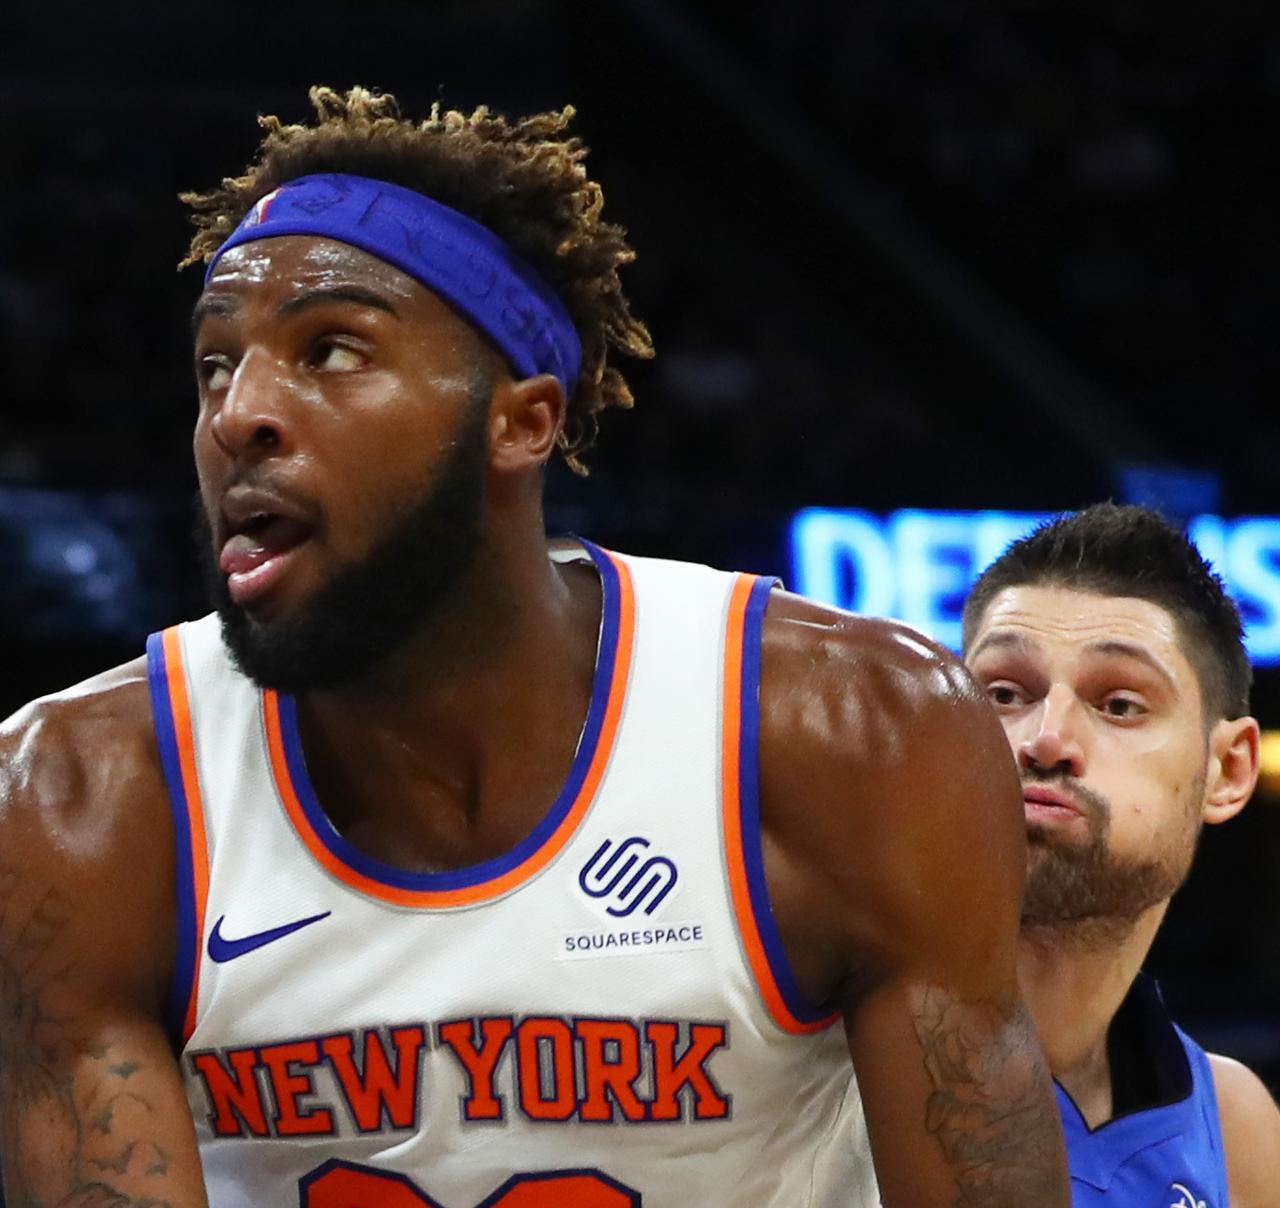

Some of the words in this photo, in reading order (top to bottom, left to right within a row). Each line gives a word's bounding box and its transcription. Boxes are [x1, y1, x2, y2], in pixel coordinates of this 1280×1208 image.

[564, 925, 704, 952] SQUARESPACE
[192, 1023, 426, 1138] NEW
[439, 1014, 732, 1125] YORK
